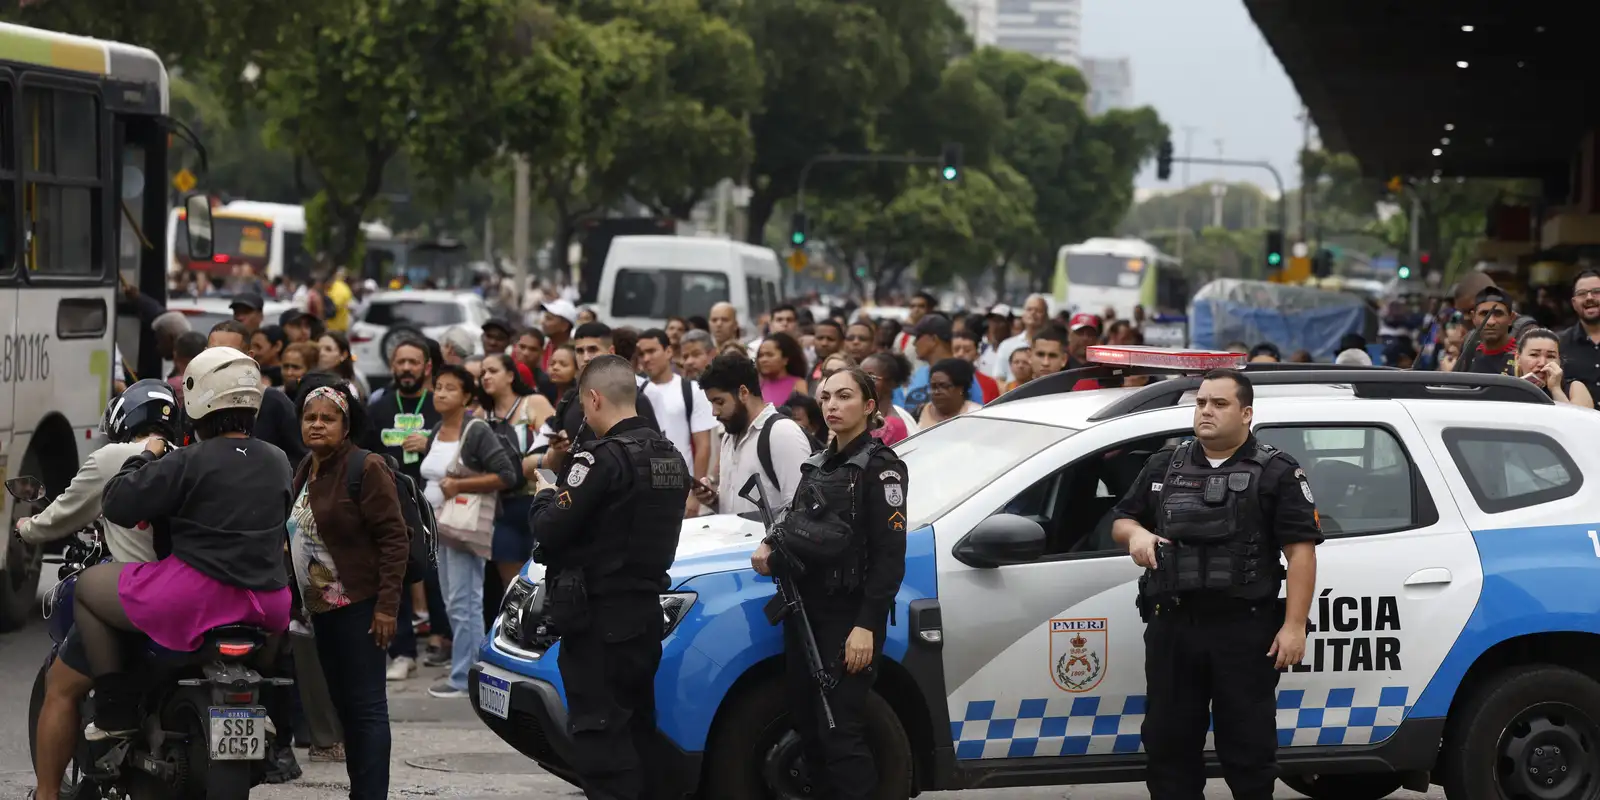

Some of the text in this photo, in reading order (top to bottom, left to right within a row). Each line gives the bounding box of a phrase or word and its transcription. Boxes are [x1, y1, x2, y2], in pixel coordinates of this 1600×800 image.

[3, 332, 49, 382] B10116
[1306, 588, 1401, 632] ÍCIA
[1053, 621, 1104, 630] PMERJ
[223, 718, 255, 736] SSB
[218, 737, 259, 755] 6C59
